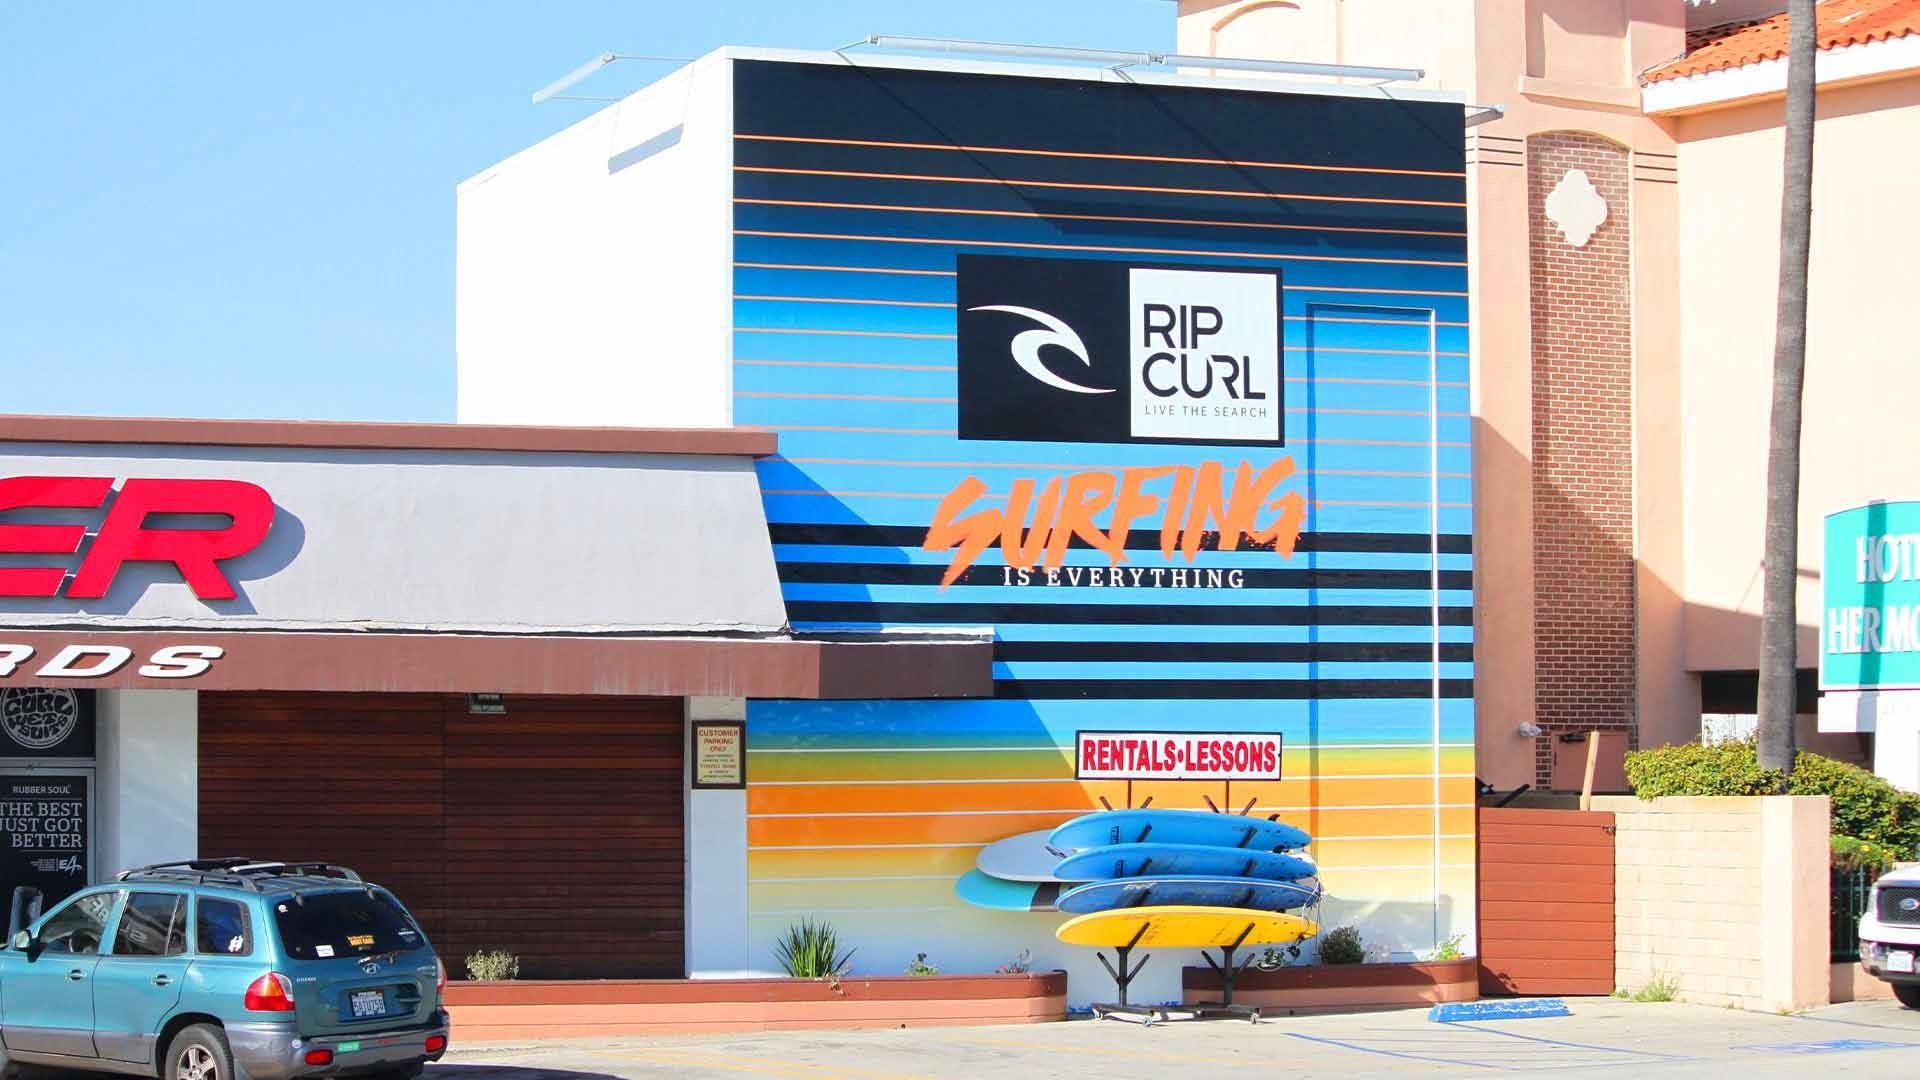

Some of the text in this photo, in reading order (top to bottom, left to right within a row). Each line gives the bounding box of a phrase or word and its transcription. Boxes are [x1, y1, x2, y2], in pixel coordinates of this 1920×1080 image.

[1143, 303, 1224, 349] RIP
[1142, 352, 1266, 400] CURL
[1145, 404, 1267, 418] LIVE THE SEARCH
[922, 455, 1307, 593] SURFING
[1003, 566, 1245, 588] IS EVERYTHING
[1082, 739, 1276, 772] RENTALS LESSONS
[12, 785, 71, 794] RUBBER SOUL
[0, 802, 82, 817] THE BEST
[44, 818, 82, 832] GOT
[11, 833, 82, 848] BETTER
